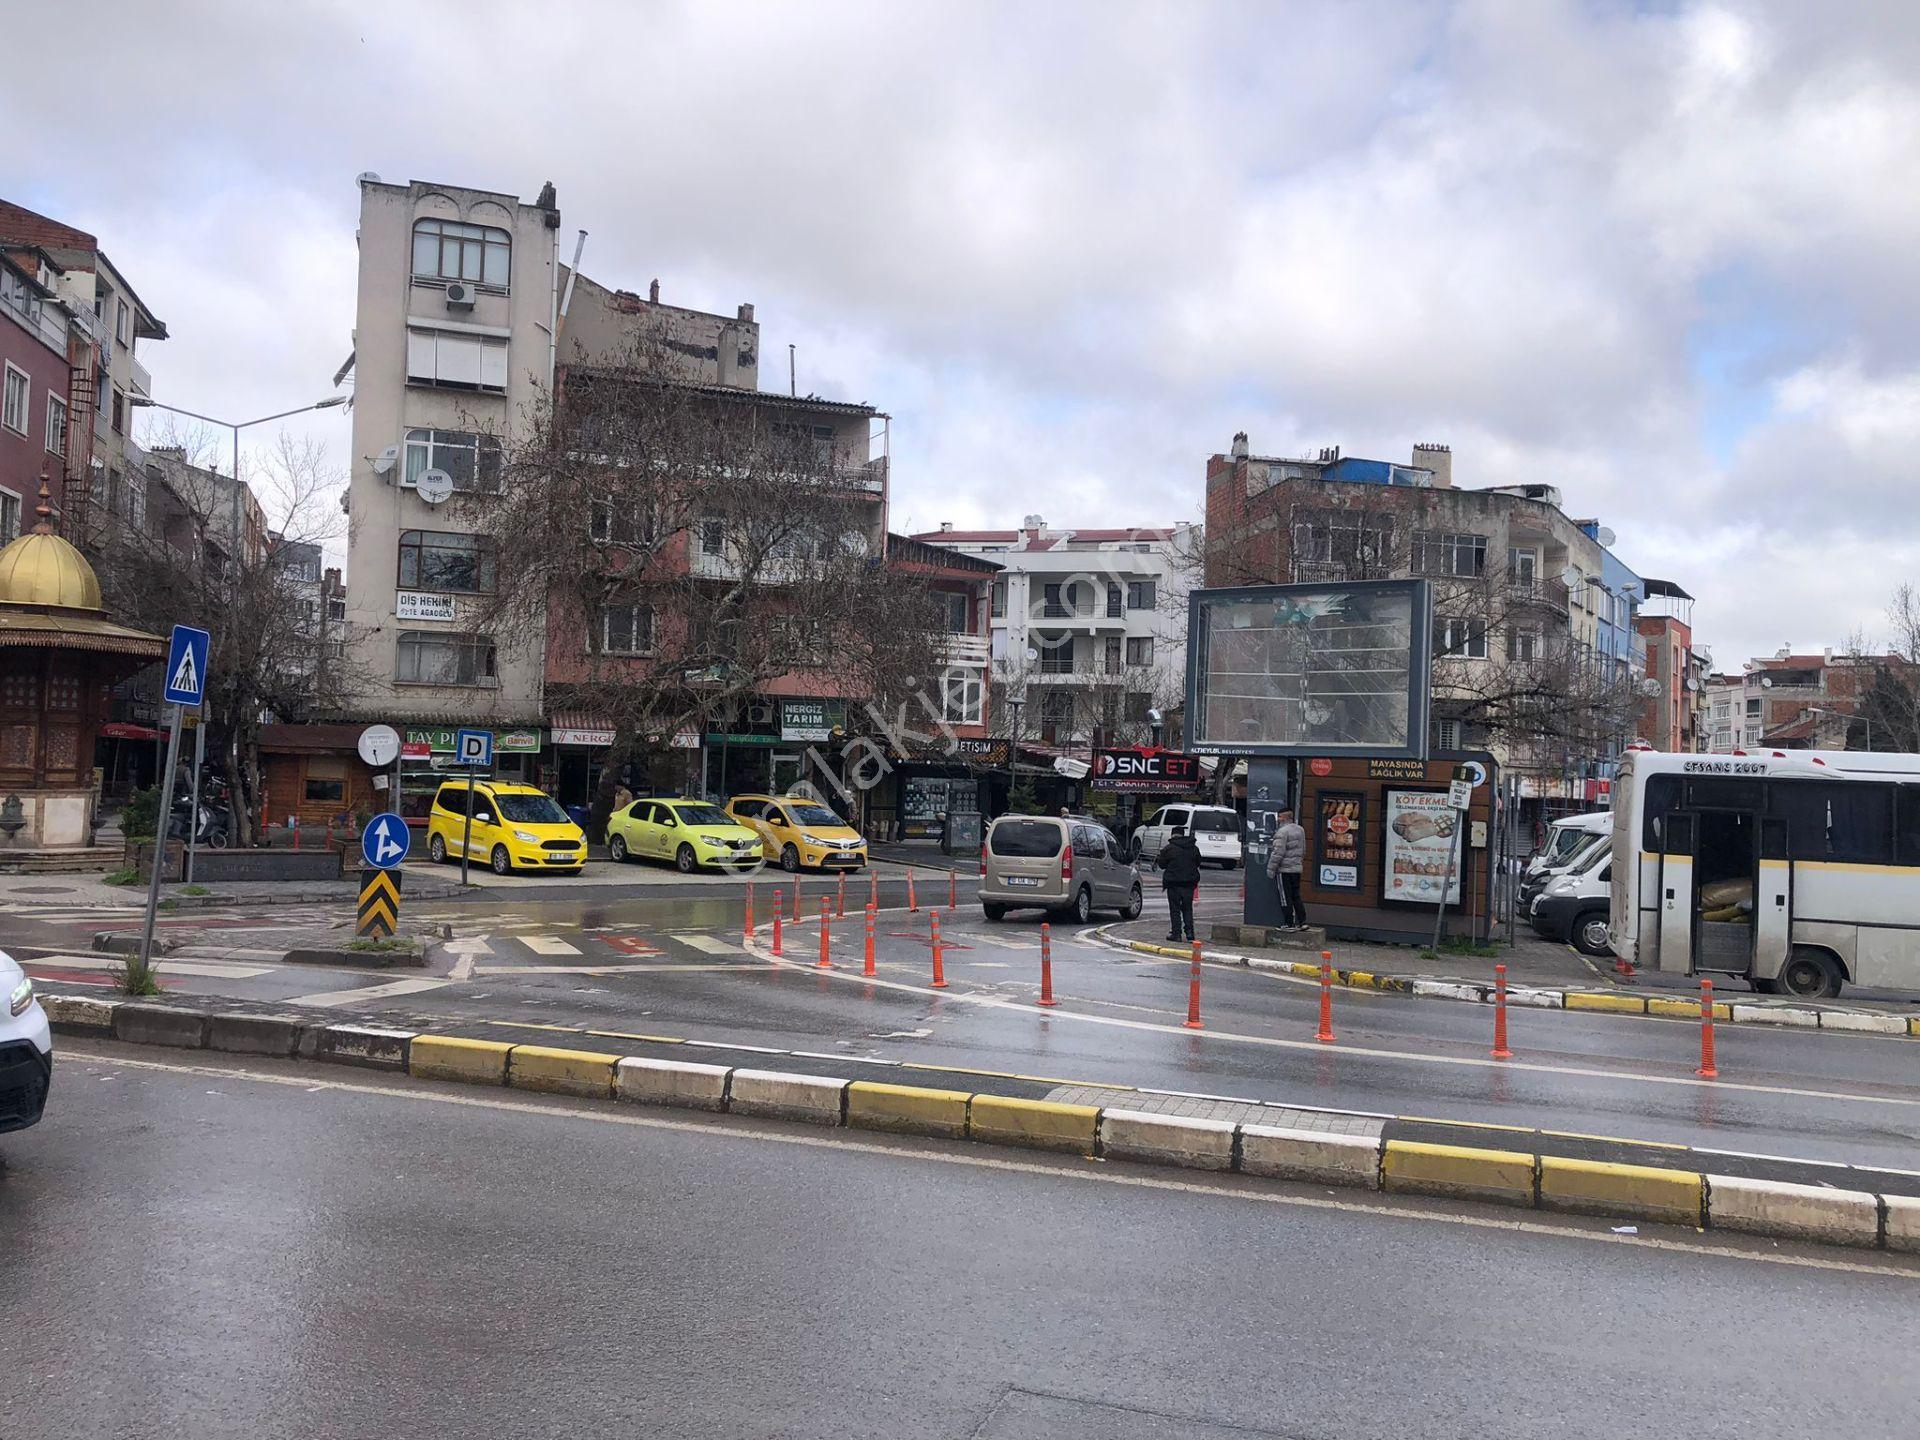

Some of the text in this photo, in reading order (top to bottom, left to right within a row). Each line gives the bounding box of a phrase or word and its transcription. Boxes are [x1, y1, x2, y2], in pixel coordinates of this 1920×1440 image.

[785, 704, 822, 714] NERGİZ
[785, 714, 823, 724] TARIM
[406, 731, 435, 745] TAY
[506, 736, 534, 746] Banvit
[467, 738, 482, 756] D
[1117, 757, 1191, 774] SNC ET
[1371, 760, 1424, 769] MAYASINDA
[1419, 797, 1447, 806] EKME
